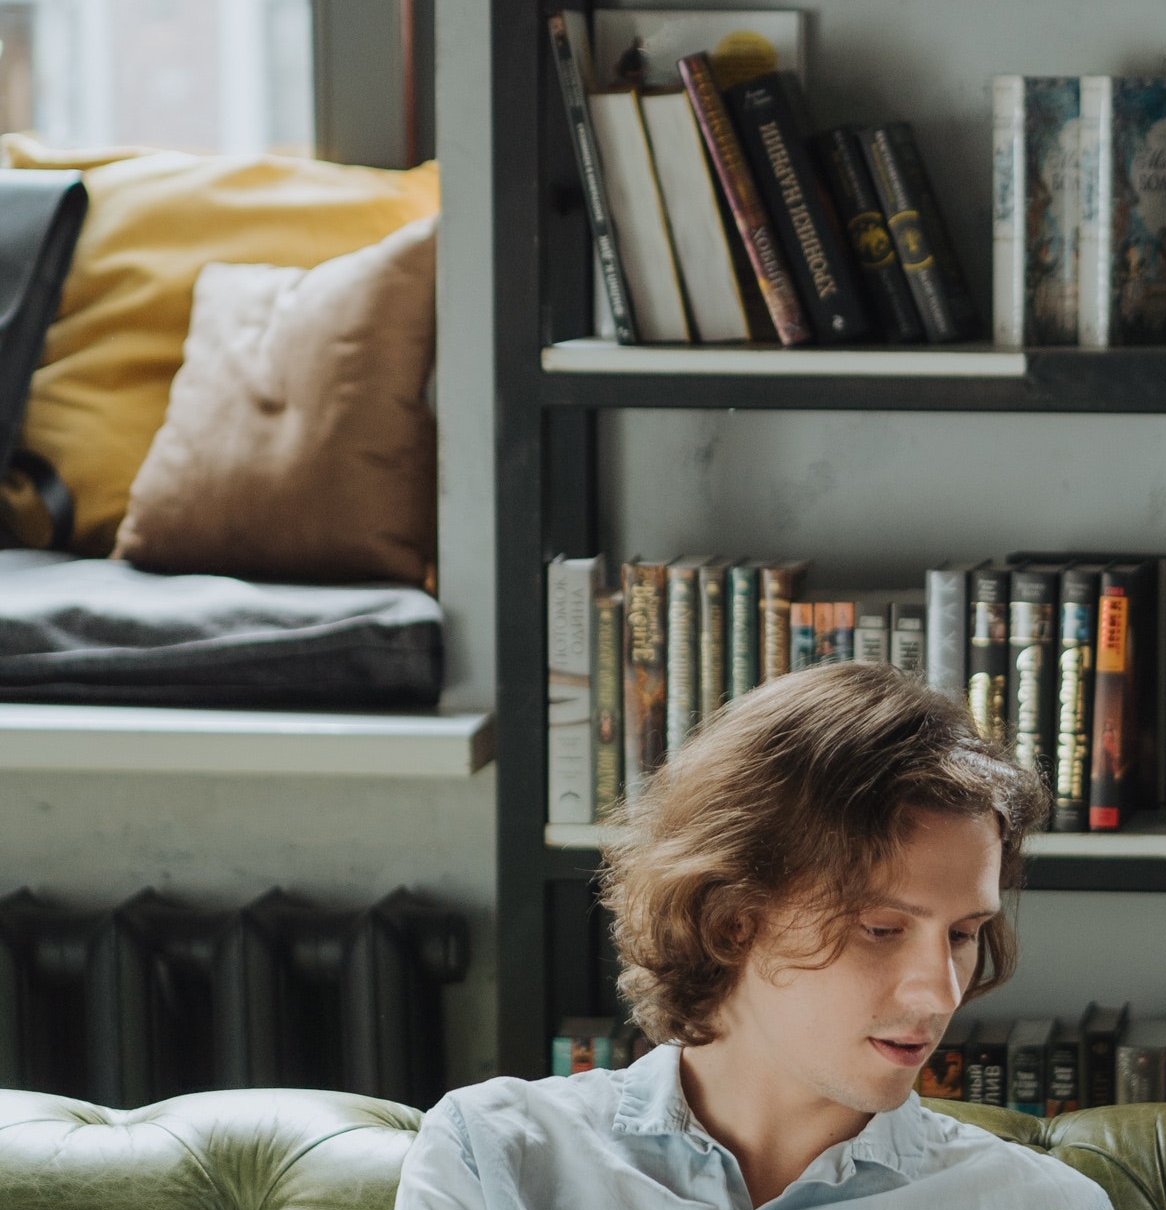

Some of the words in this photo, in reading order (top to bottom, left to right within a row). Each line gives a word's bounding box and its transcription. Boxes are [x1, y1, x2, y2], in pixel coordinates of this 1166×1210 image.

[759, 120, 803, 204] НАРНИИ
[788, 201, 838, 298] ХРОНИКИ
[553, 577, 568, 665] ПОТОМОК
